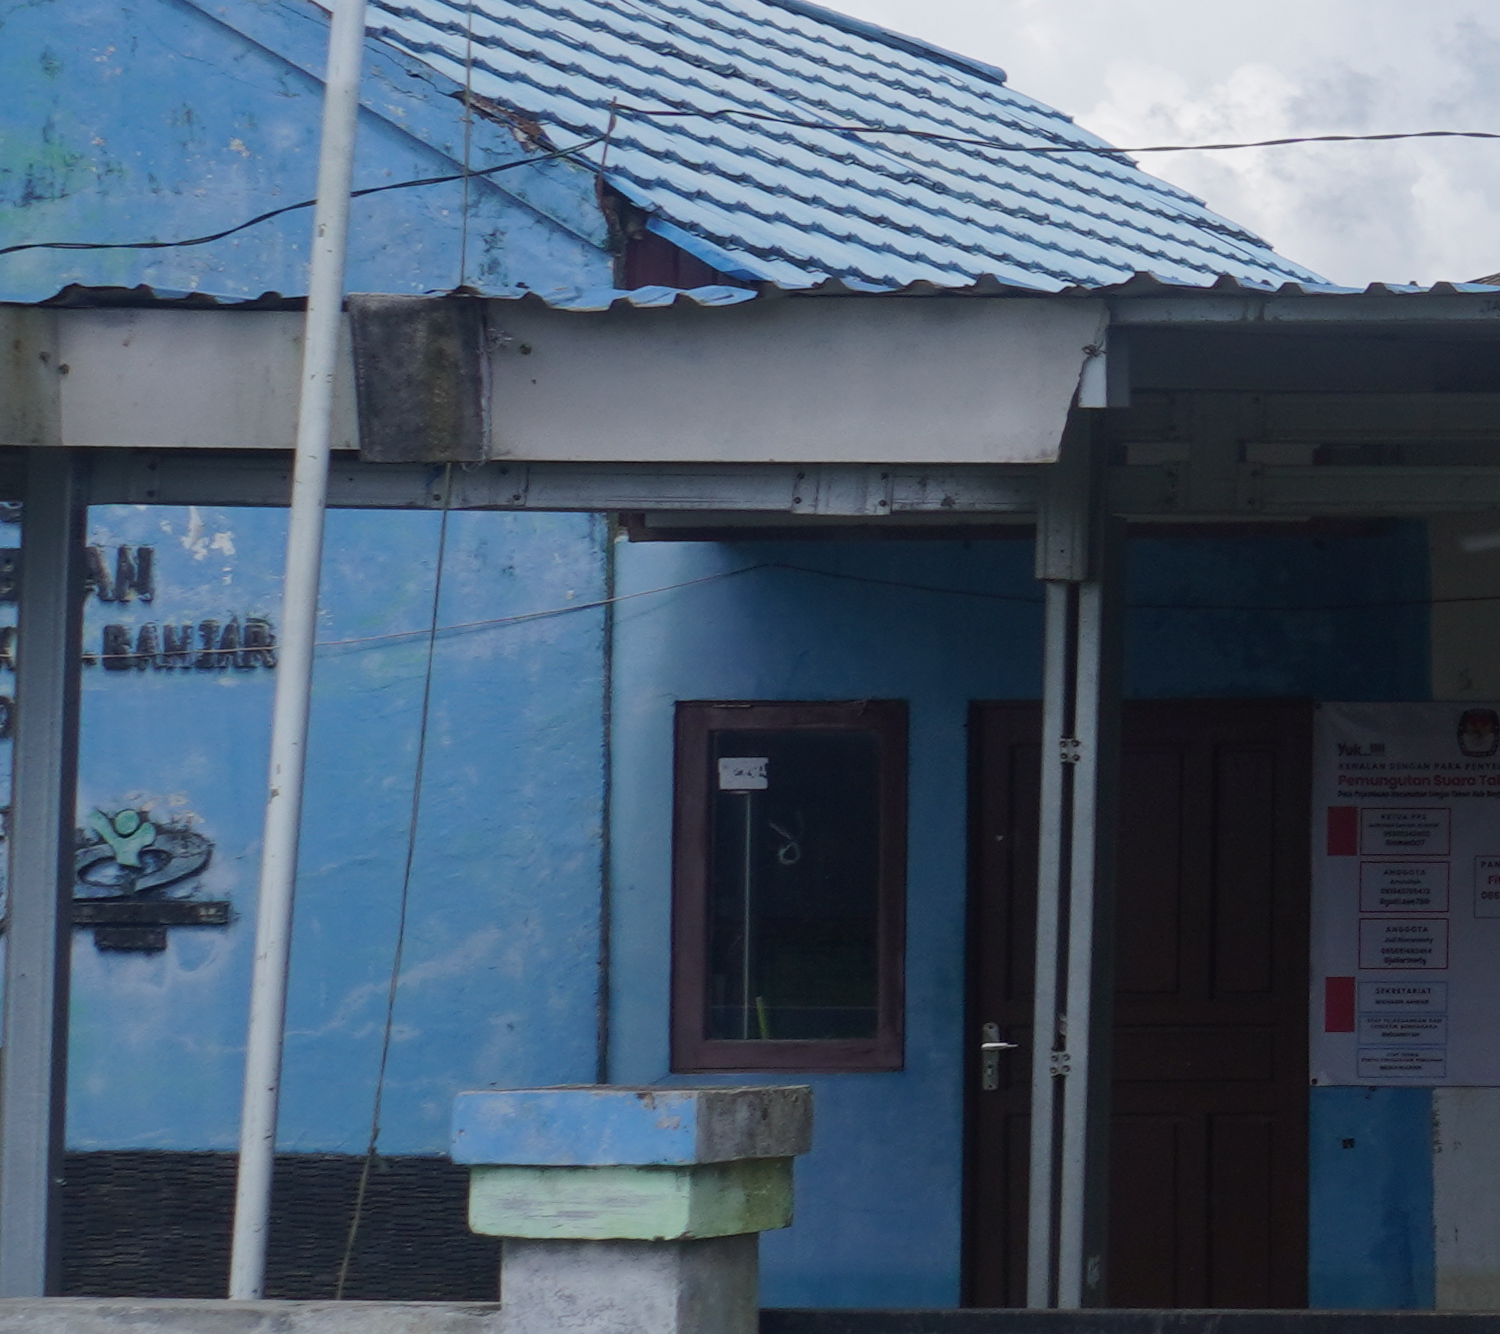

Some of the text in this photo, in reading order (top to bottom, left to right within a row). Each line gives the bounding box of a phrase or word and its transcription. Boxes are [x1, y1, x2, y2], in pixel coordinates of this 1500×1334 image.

[102, 622, 278, 672] BANJAR
[1434, 762, 1460, 770] PARA
[1338, 774, 1430, 790] Pemungutan
[1434, 773, 1476, 786] Suara
